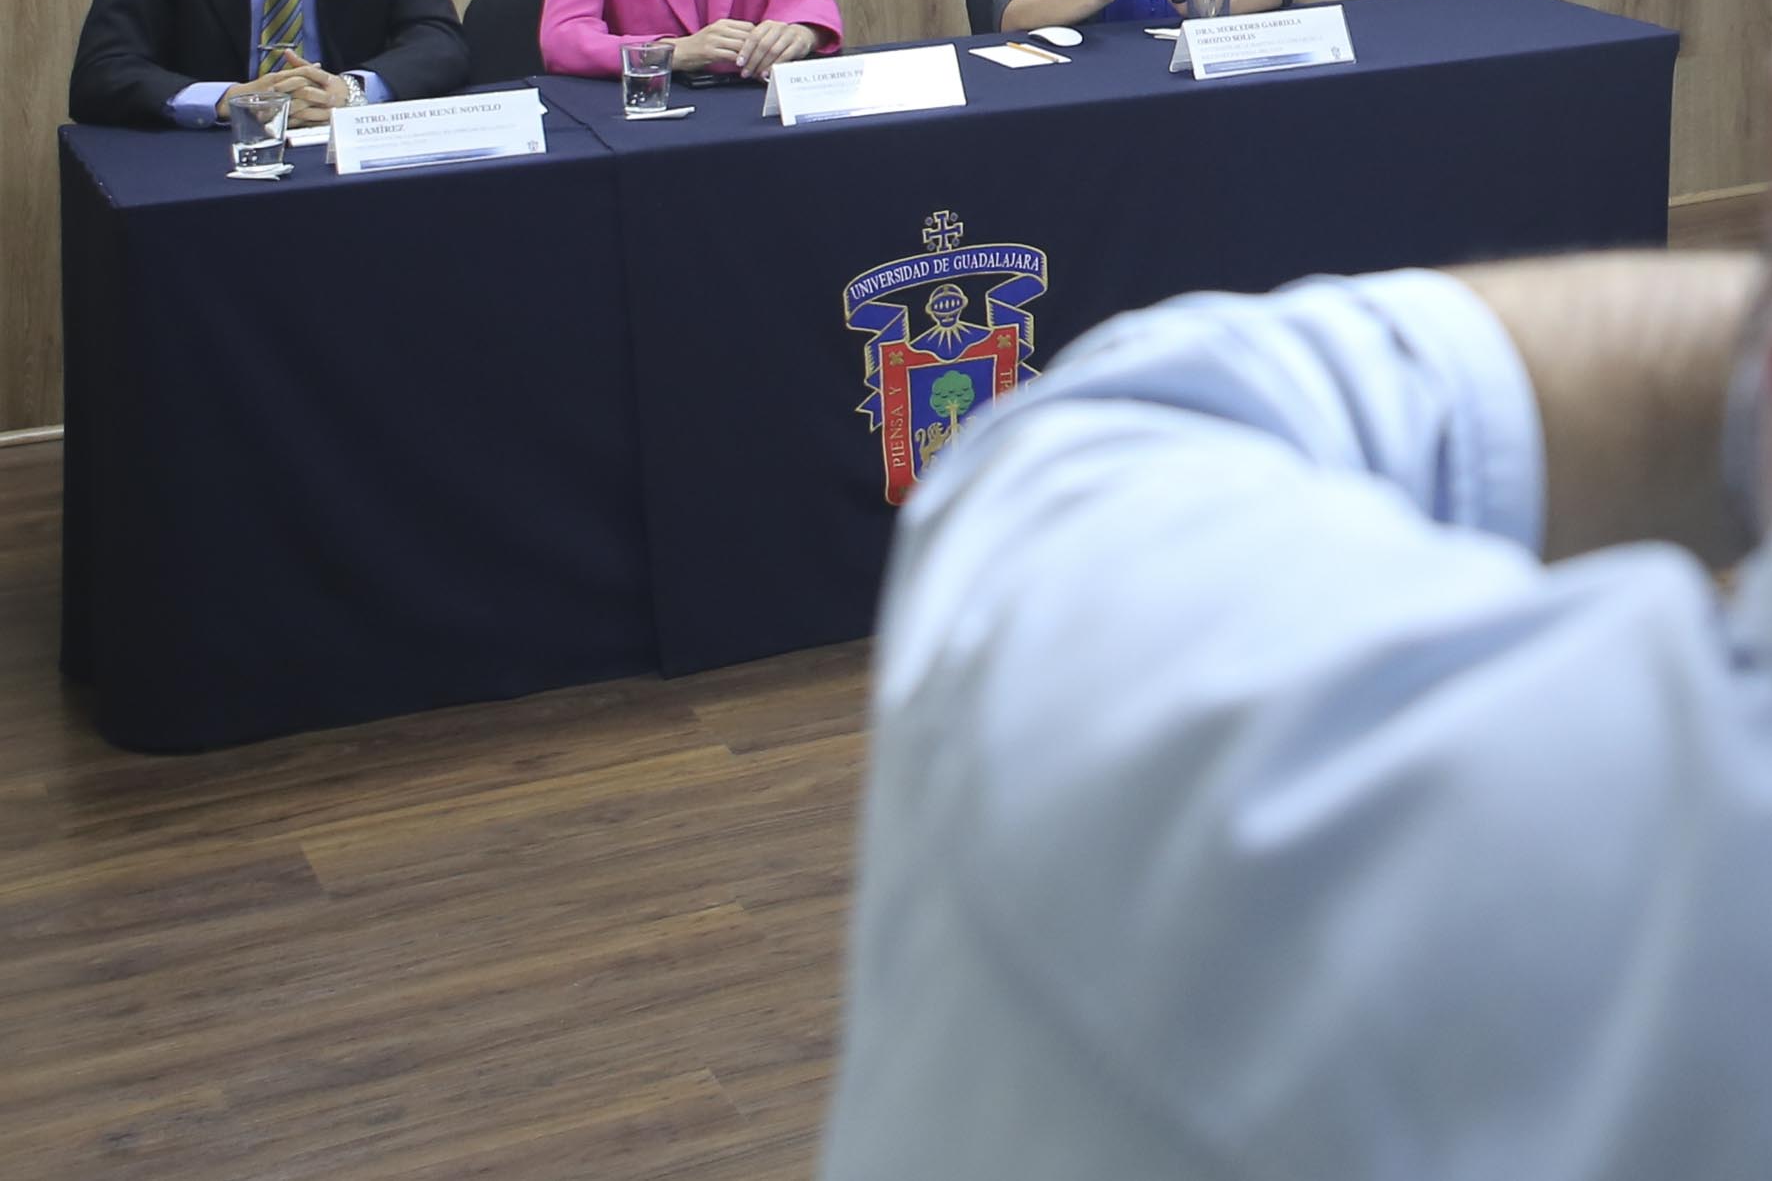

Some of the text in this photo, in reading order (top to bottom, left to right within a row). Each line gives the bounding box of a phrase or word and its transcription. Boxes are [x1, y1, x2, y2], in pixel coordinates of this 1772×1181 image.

[354, 114, 389, 125] MTRO.
[391, 110, 427, 121] HIRAM
[459, 103, 502, 114] NOVELO
[849, 251, 1040, 300] UNIVERSIDAD DE GUADALAJARA
[888, 386, 907, 468] PIENSA Y
